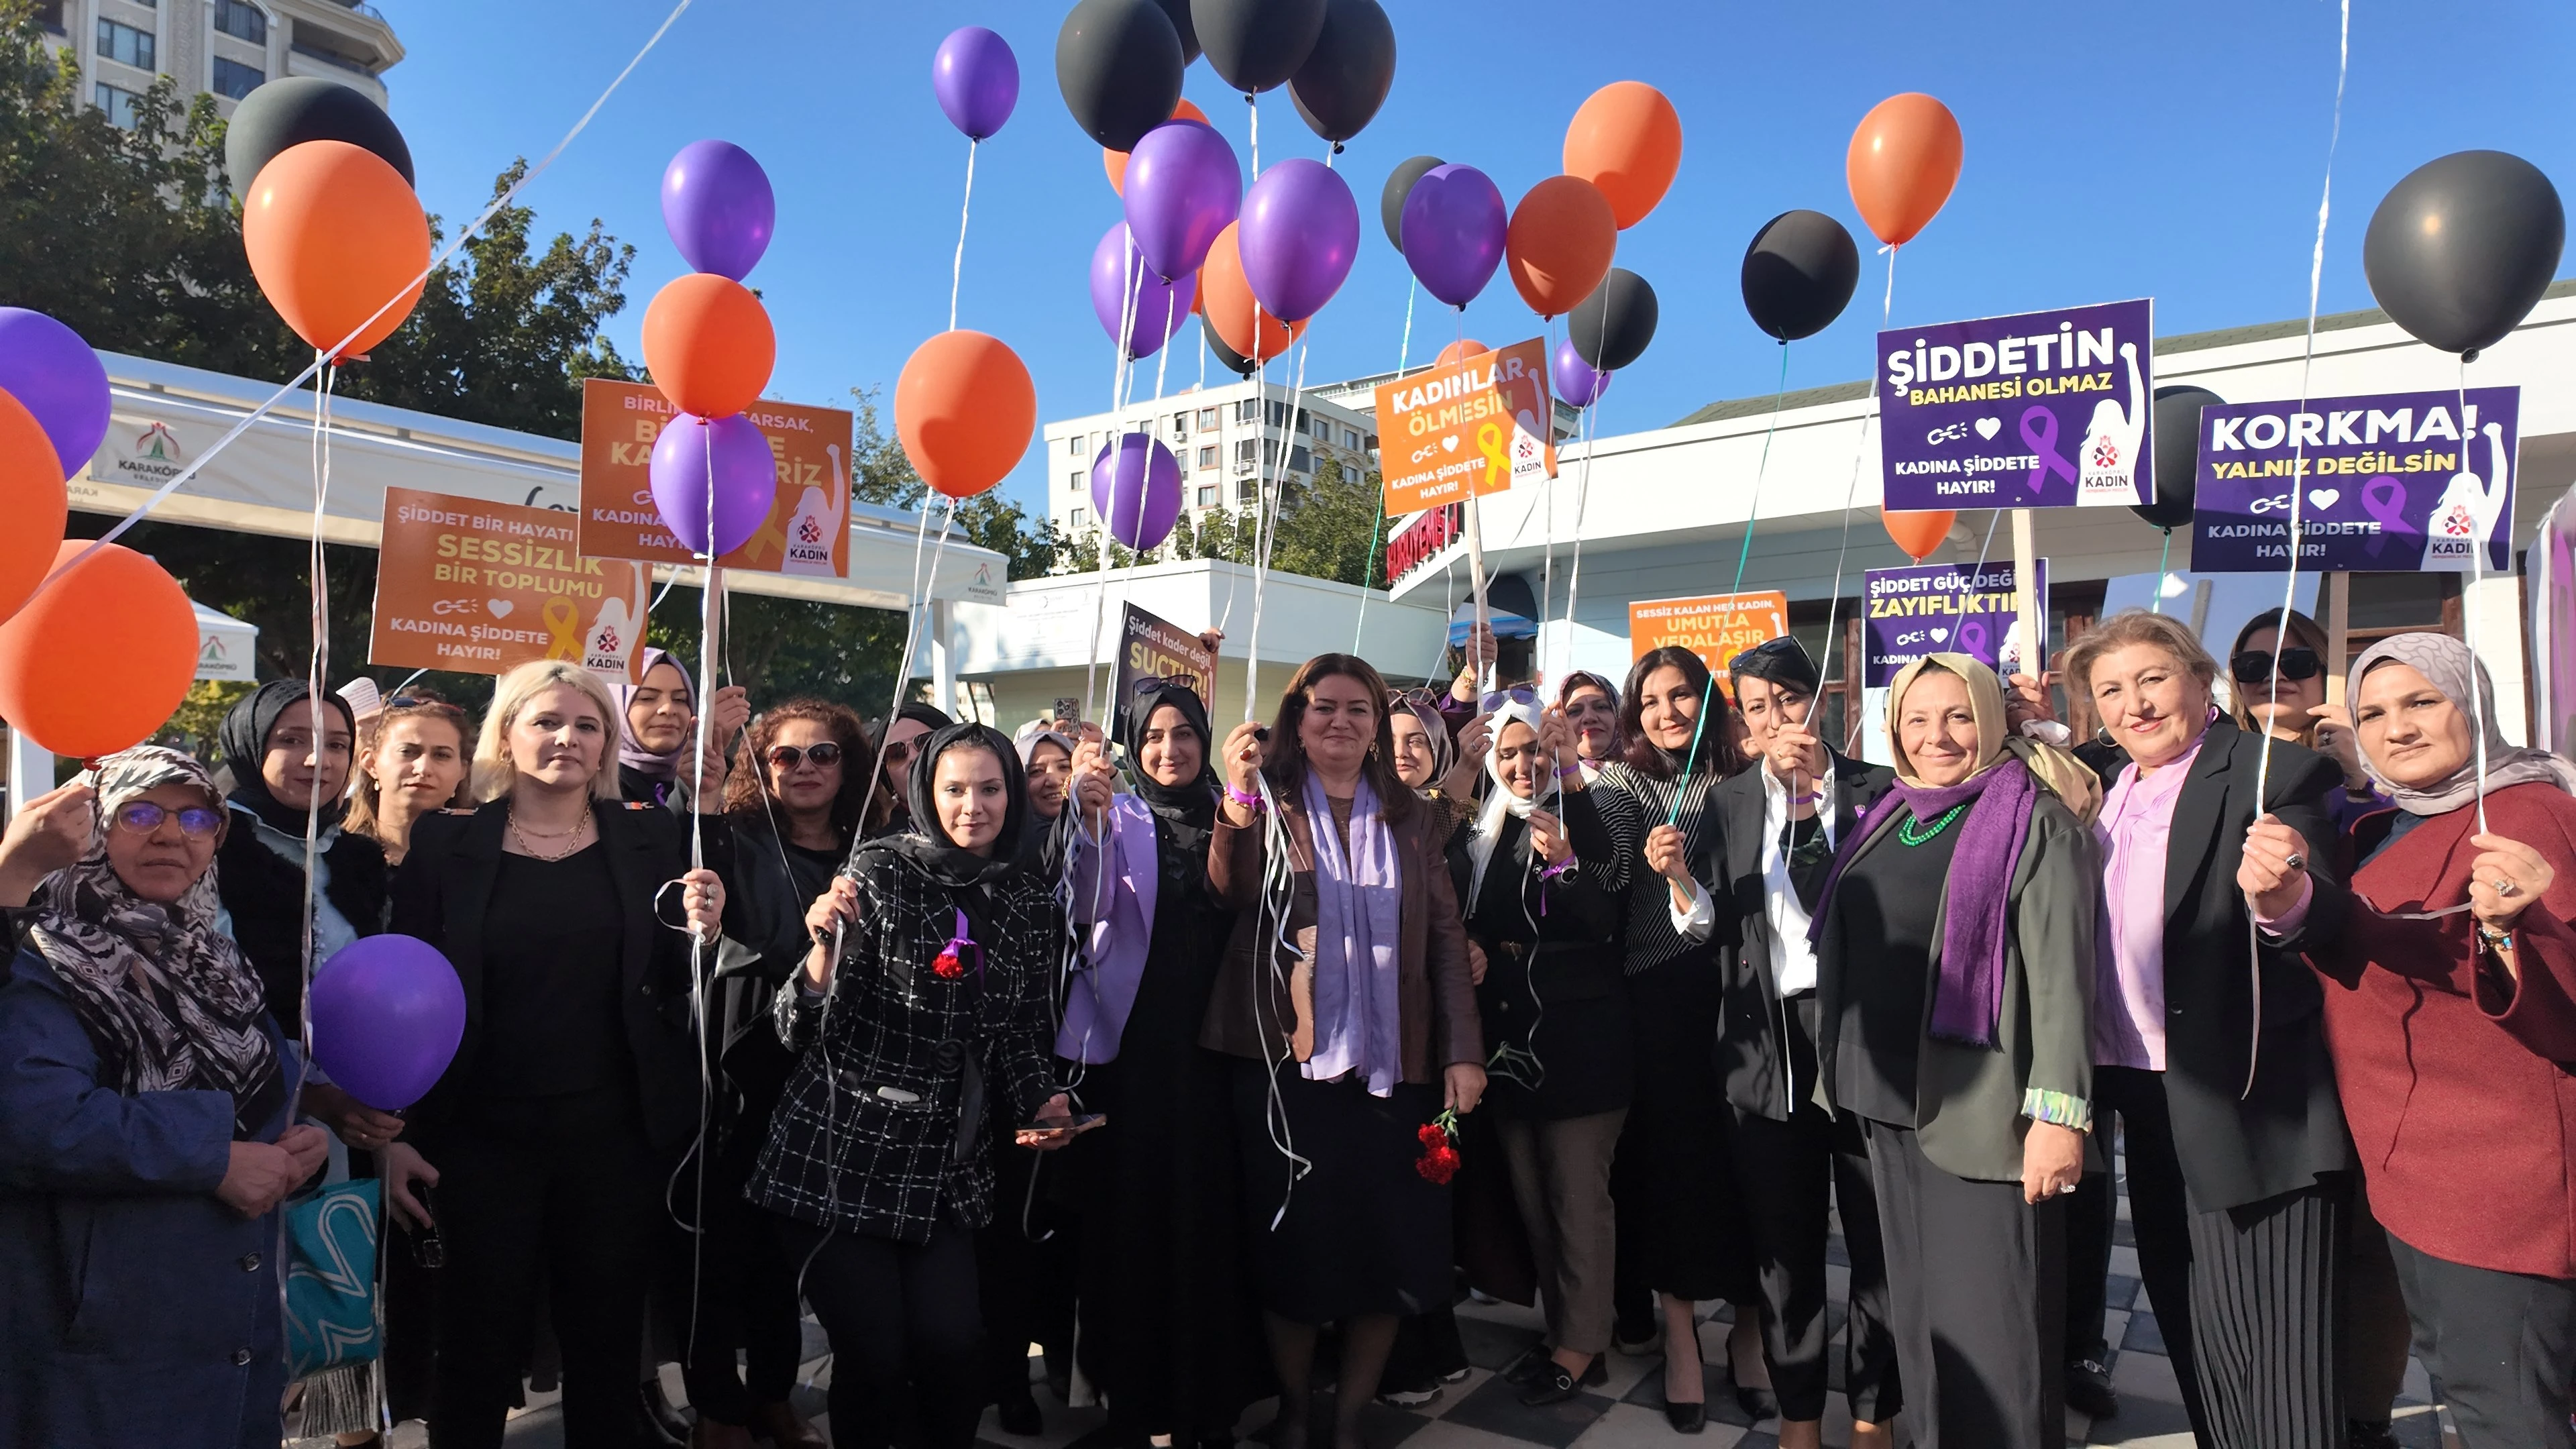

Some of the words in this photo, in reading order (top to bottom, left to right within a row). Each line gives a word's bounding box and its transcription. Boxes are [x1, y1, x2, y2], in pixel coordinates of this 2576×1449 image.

[1888, 321, 2113, 397] ŞİDDETİN
[1392, 357, 1525, 415] KADINLAR
[1911, 376, 2021, 406] BAHANESİ
[2027, 372, 2112, 396] OLMAZ
[1409, 389, 1513, 436] ÖLMESİN
[2212, 405, 2477, 451] KORKMA!
[1391, 471, 1436, 490] KADINA
[1436, 458, 1486, 482] ŞİDDETE
[1514, 461, 1541, 474] KADIN
[1895, 460, 1961, 475] KADINA
[1964, 455, 2040, 477] ŞİDDETE
[2212, 458, 2310, 480] YALNIZ
[2317, 449, 2455, 475] DEĞİLSİN
[1420, 481, 1458, 499] HAYIR!
[1937, 480, 1995, 494] HAYIR!
[2085, 475, 2128, 488] KADIN
[398, 504, 469, 527] ŞİDDET
[472, 514, 504, 532] BİR
[508, 521, 574, 542] HAYATI
[593, 508, 667, 527] KADINA
[2208, 524, 2287, 538] KADINA
[790, 548, 828, 560] KADIN
[435, 561, 478, 584] BİR
[483, 570, 602, 599] TOPLUMU
[1870, 577, 1931, 598] ŞİDDET
[1933, 572, 1971, 593] GÜÇ
[1637, 606, 1672, 618] SESSİZ
[1674, 605, 1711, 615] KALAN
[1713, 603, 1735, 613] HER
[1737, 600, 1774, 610] KADIN,
[390, 617, 466, 637] KADINA
[470, 623, 548, 645] ŞİDDETE
[1667, 613, 1750, 632] UMUTLA
[1128, 615, 1161, 644] Şiddet
[1163, 632, 1189, 656] kader
[1190, 648, 1212, 669] değil,
[1653, 629, 1765, 649] VEDALAŞIR
[437, 643, 501, 660] HAYIR!
[1873, 655, 1916, 665] KADINA
[587, 657, 625, 669] KADIN
